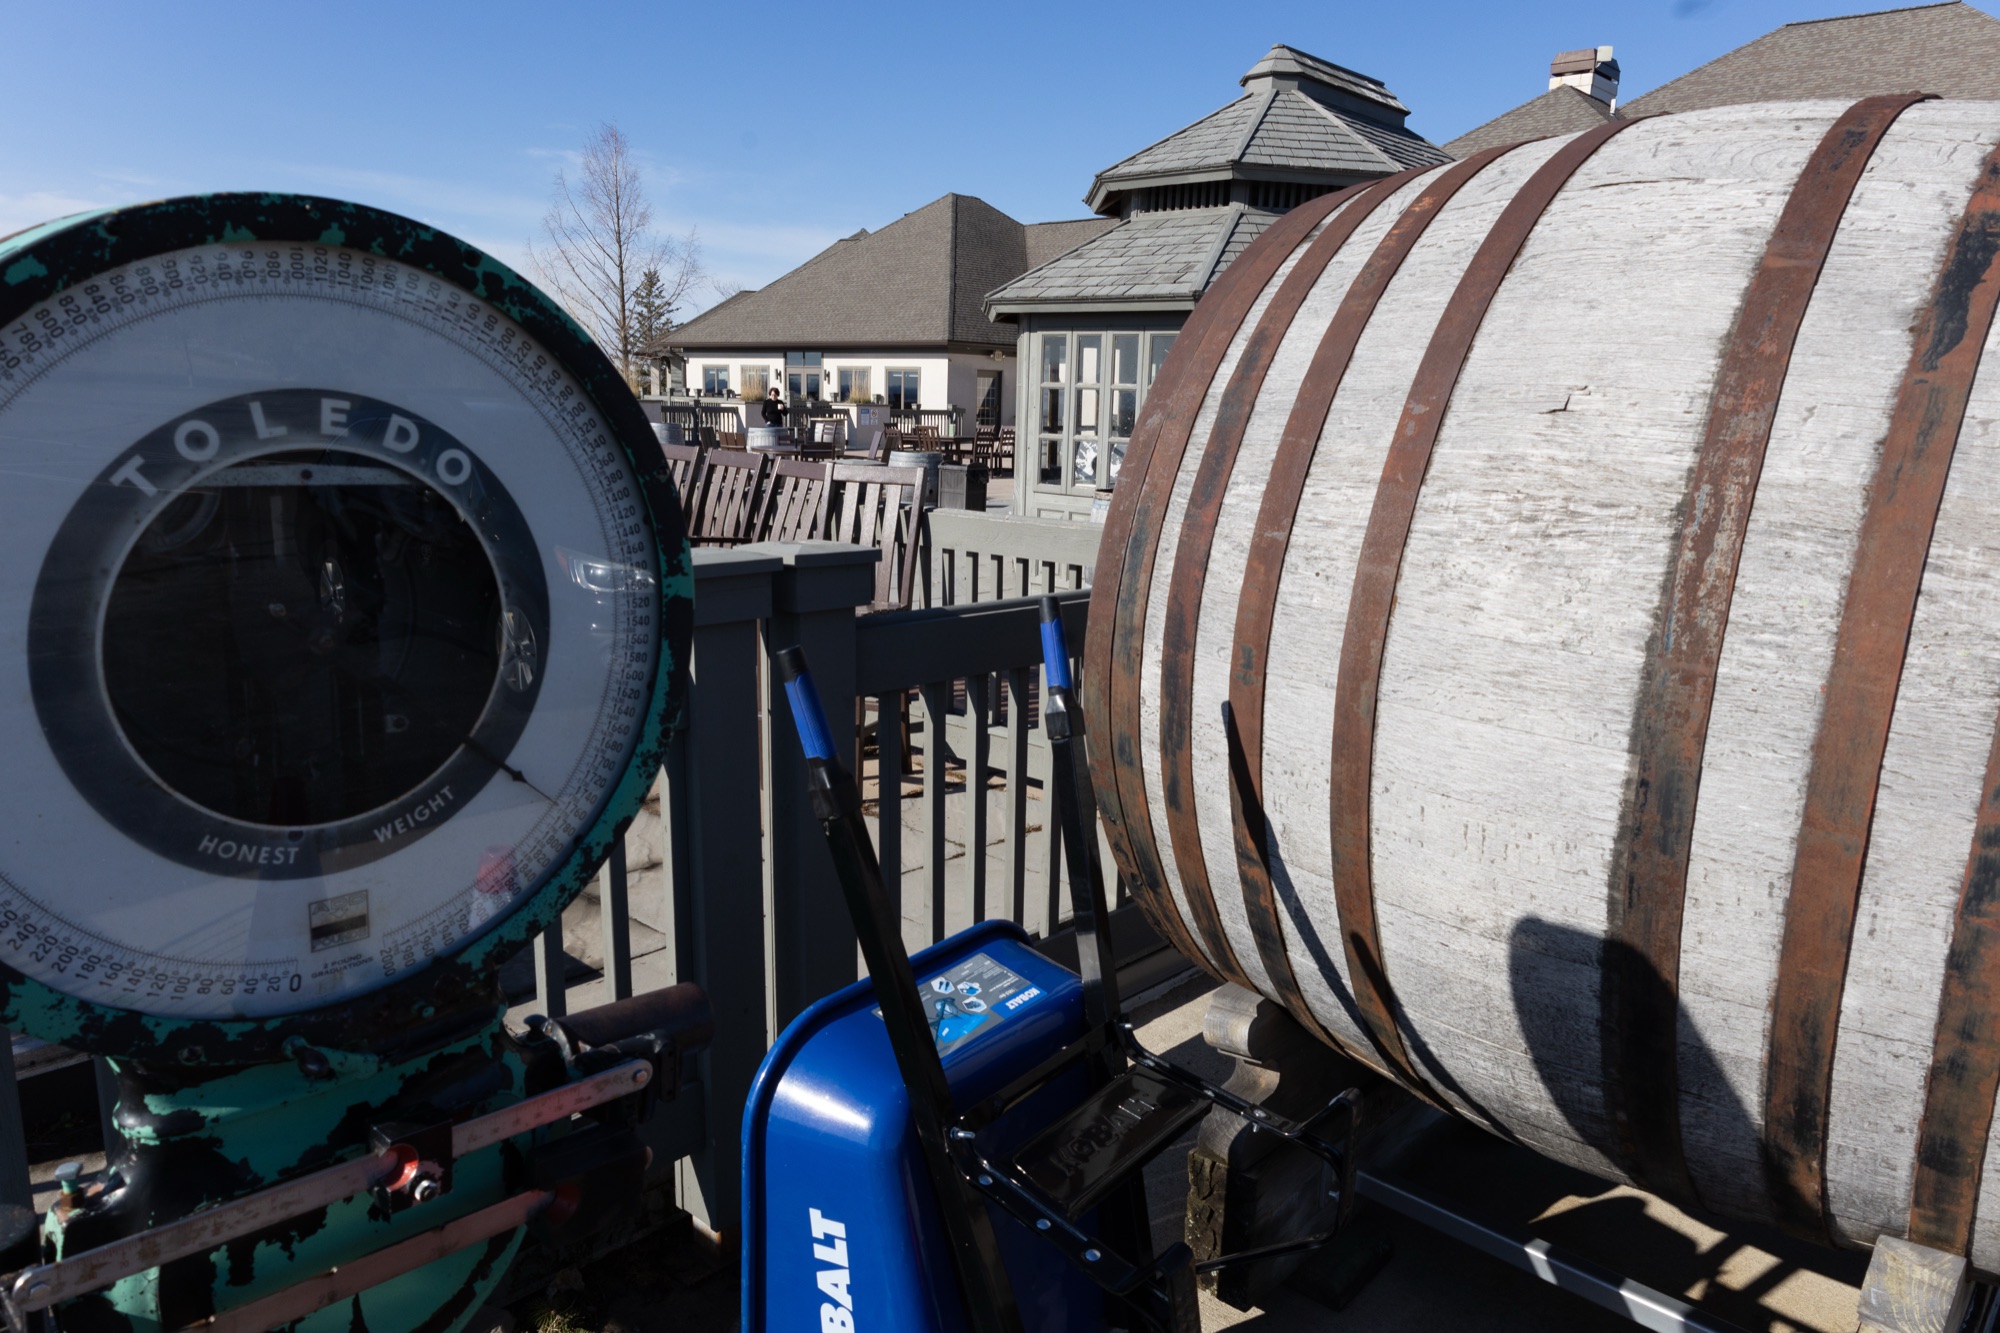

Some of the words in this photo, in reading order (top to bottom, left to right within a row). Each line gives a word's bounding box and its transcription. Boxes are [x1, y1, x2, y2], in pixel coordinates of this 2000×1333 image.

[187, 256, 210, 285] 920
[213, 253, 234, 281] 940
[239, 252, 258, 279] 960
[264, 252, 282, 279] 980
[289, 245, 305, 280] 1000
[314, 246, 328, 283] 1020
[338, 250, 352, 287] 1040
[360, 256, 375, 292] 1060
[135, 267, 161, 297] 880
[161, 261, 185, 290] 900
[402, 271, 420, 305] 1100
[84, 285, 113, 315] 840
[109, 275, 137, 305] 860
[422, 280, 441, 314] 1120
[59, 296, 89, 326] 820
[441, 290, 461, 323] 1140
[460, 301, 480, 333] 1160
[34, 309, 66, 339] 800
[477, 313, 498, 344] 1180
[11, 324, 44, 353] 780
[494, 326, 515, 356] 1200
[0, 340, 23, 369] 60
[509, 340, 531, 368] 1220
[524, 354, 547, 381] 1240
[538, 369, 561, 395] 1260
[550, 384, 574, 410] 1280
[562, 400, 586, 425] 1300
[573, 416, 597, 440] 1320
[110, 398, 472, 498] TOLEDO
[583, 433, 607, 456] 1340
[591, 450, 616, 472] 1360
[599, 468, 624, 489] 1380
[606, 486, 630, 505] 1400
[612, 504, 636, 522] 1420
[616, 522, 641, 539] 1440
[620, 541, 645, 557] 1460
[626, 596, 650, 609] 1520
[626, 615, 650, 627] 1540
[625, 634, 649, 644] 1560
[623, 652, 647, 663] 1580
[620, 669, 644, 681] 1600
[616, 686, 640, 700] 1620
[611, 703, 635, 718] 1640
[606, 720, 629, 736] 1660
[599, 737, 623, 753] 1680
[592, 754, 615, 771] 1700
[583, 770, 606, 788] 1720
[574, 786, 597, 805] 1740
[564, 801, 586, 821] 1760
[198, 835, 299, 864] HONEST
[373, 785, 454, 843] WEIGHT
[553, 816, 575, 837] 1780
[541, 831, 563, 853] 1800
[529, 846, 550, 868] 1820
[515, 860, 536, 883] 1840
[501, 873, 521, 897] 1860
[0, 908, 17, 934] 60
[436, 920, 454, 947] 1940
[453, 909, 472, 936] 1920
[6, 922, 37, 948] 240
[28, 934, 58, 960] 220
[418, 930, 435, 958] 1960
[50, 944, 80, 971] 200
[75, 953, 101, 978] 180
[331, 954, 362, 966] POUND
[380, 945, 395, 977] 2000
[399, 939, 416, 968] 1980
[98, 961, 124, 986] 160
[122, 967, 146, 992] 140
[311, 956, 374, 979] GRADUATIONS
[146, 972, 169, 996] 120
[170, 976, 191, 999] 100
[196, 977, 214, 995] 80
[219, 978, 236, 995] 60
[242, 978, 259, 995] 40
[265, 976, 280, 993] 20
[290, 973, 302, 992] 0
[1005, 987, 1041, 1010] KOBALT
